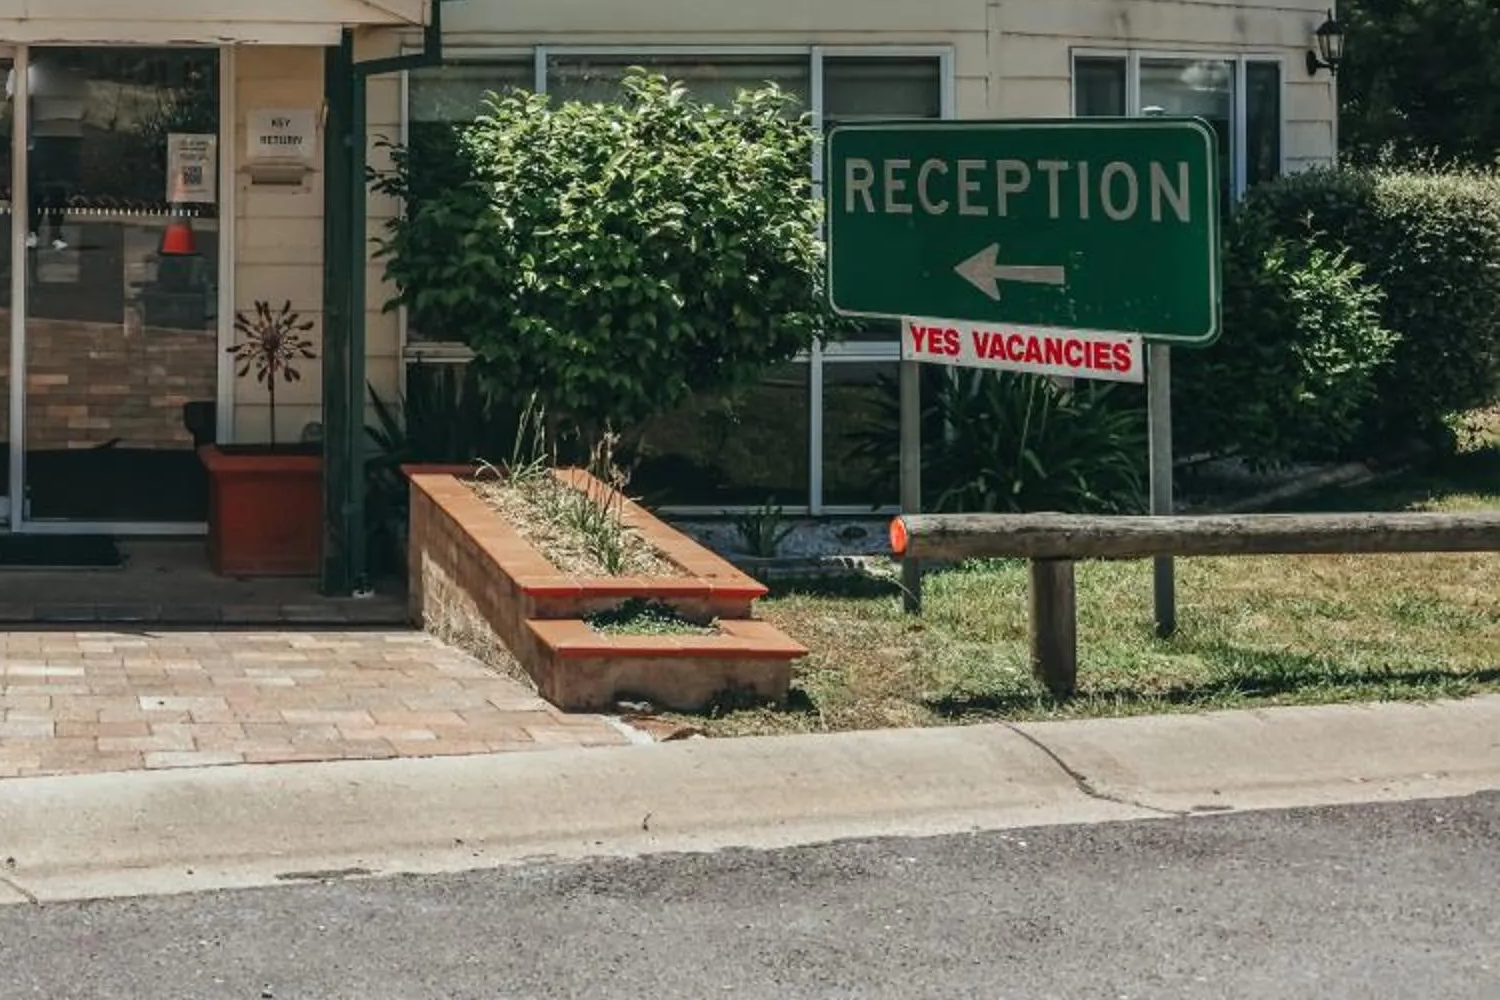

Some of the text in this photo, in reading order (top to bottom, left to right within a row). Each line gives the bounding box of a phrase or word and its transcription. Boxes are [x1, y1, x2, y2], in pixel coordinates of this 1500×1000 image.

[259, 135, 303, 146] RETURN
[844, 157, 1191, 223] RECEPTION
[910, 325, 1132, 372] YES VACANCIES
